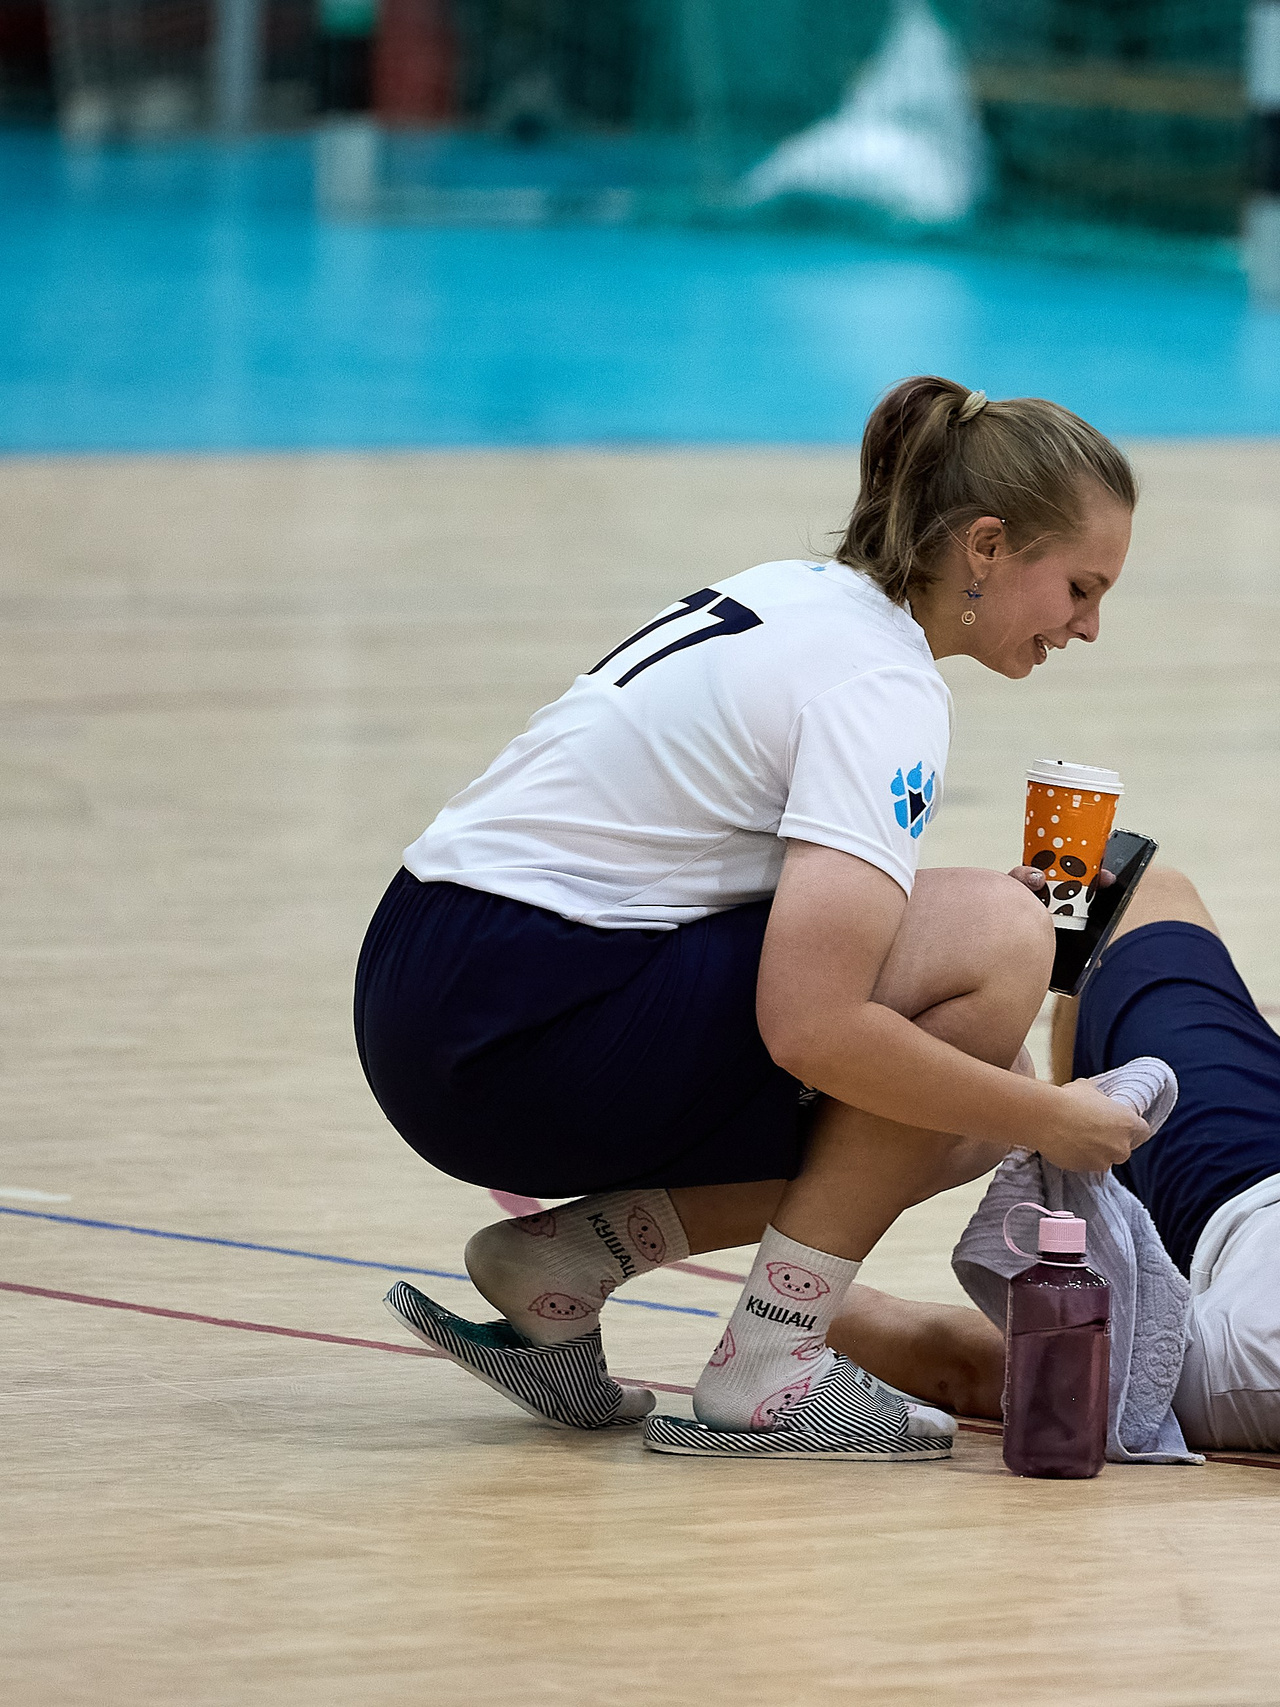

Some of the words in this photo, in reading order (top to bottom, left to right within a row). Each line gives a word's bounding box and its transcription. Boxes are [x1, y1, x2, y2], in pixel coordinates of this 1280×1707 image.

[585, 588, 764, 688] 77
[587, 1213, 636, 1278] КУШАЦ
[746, 1295, 817, 1331] КУШАЦ
